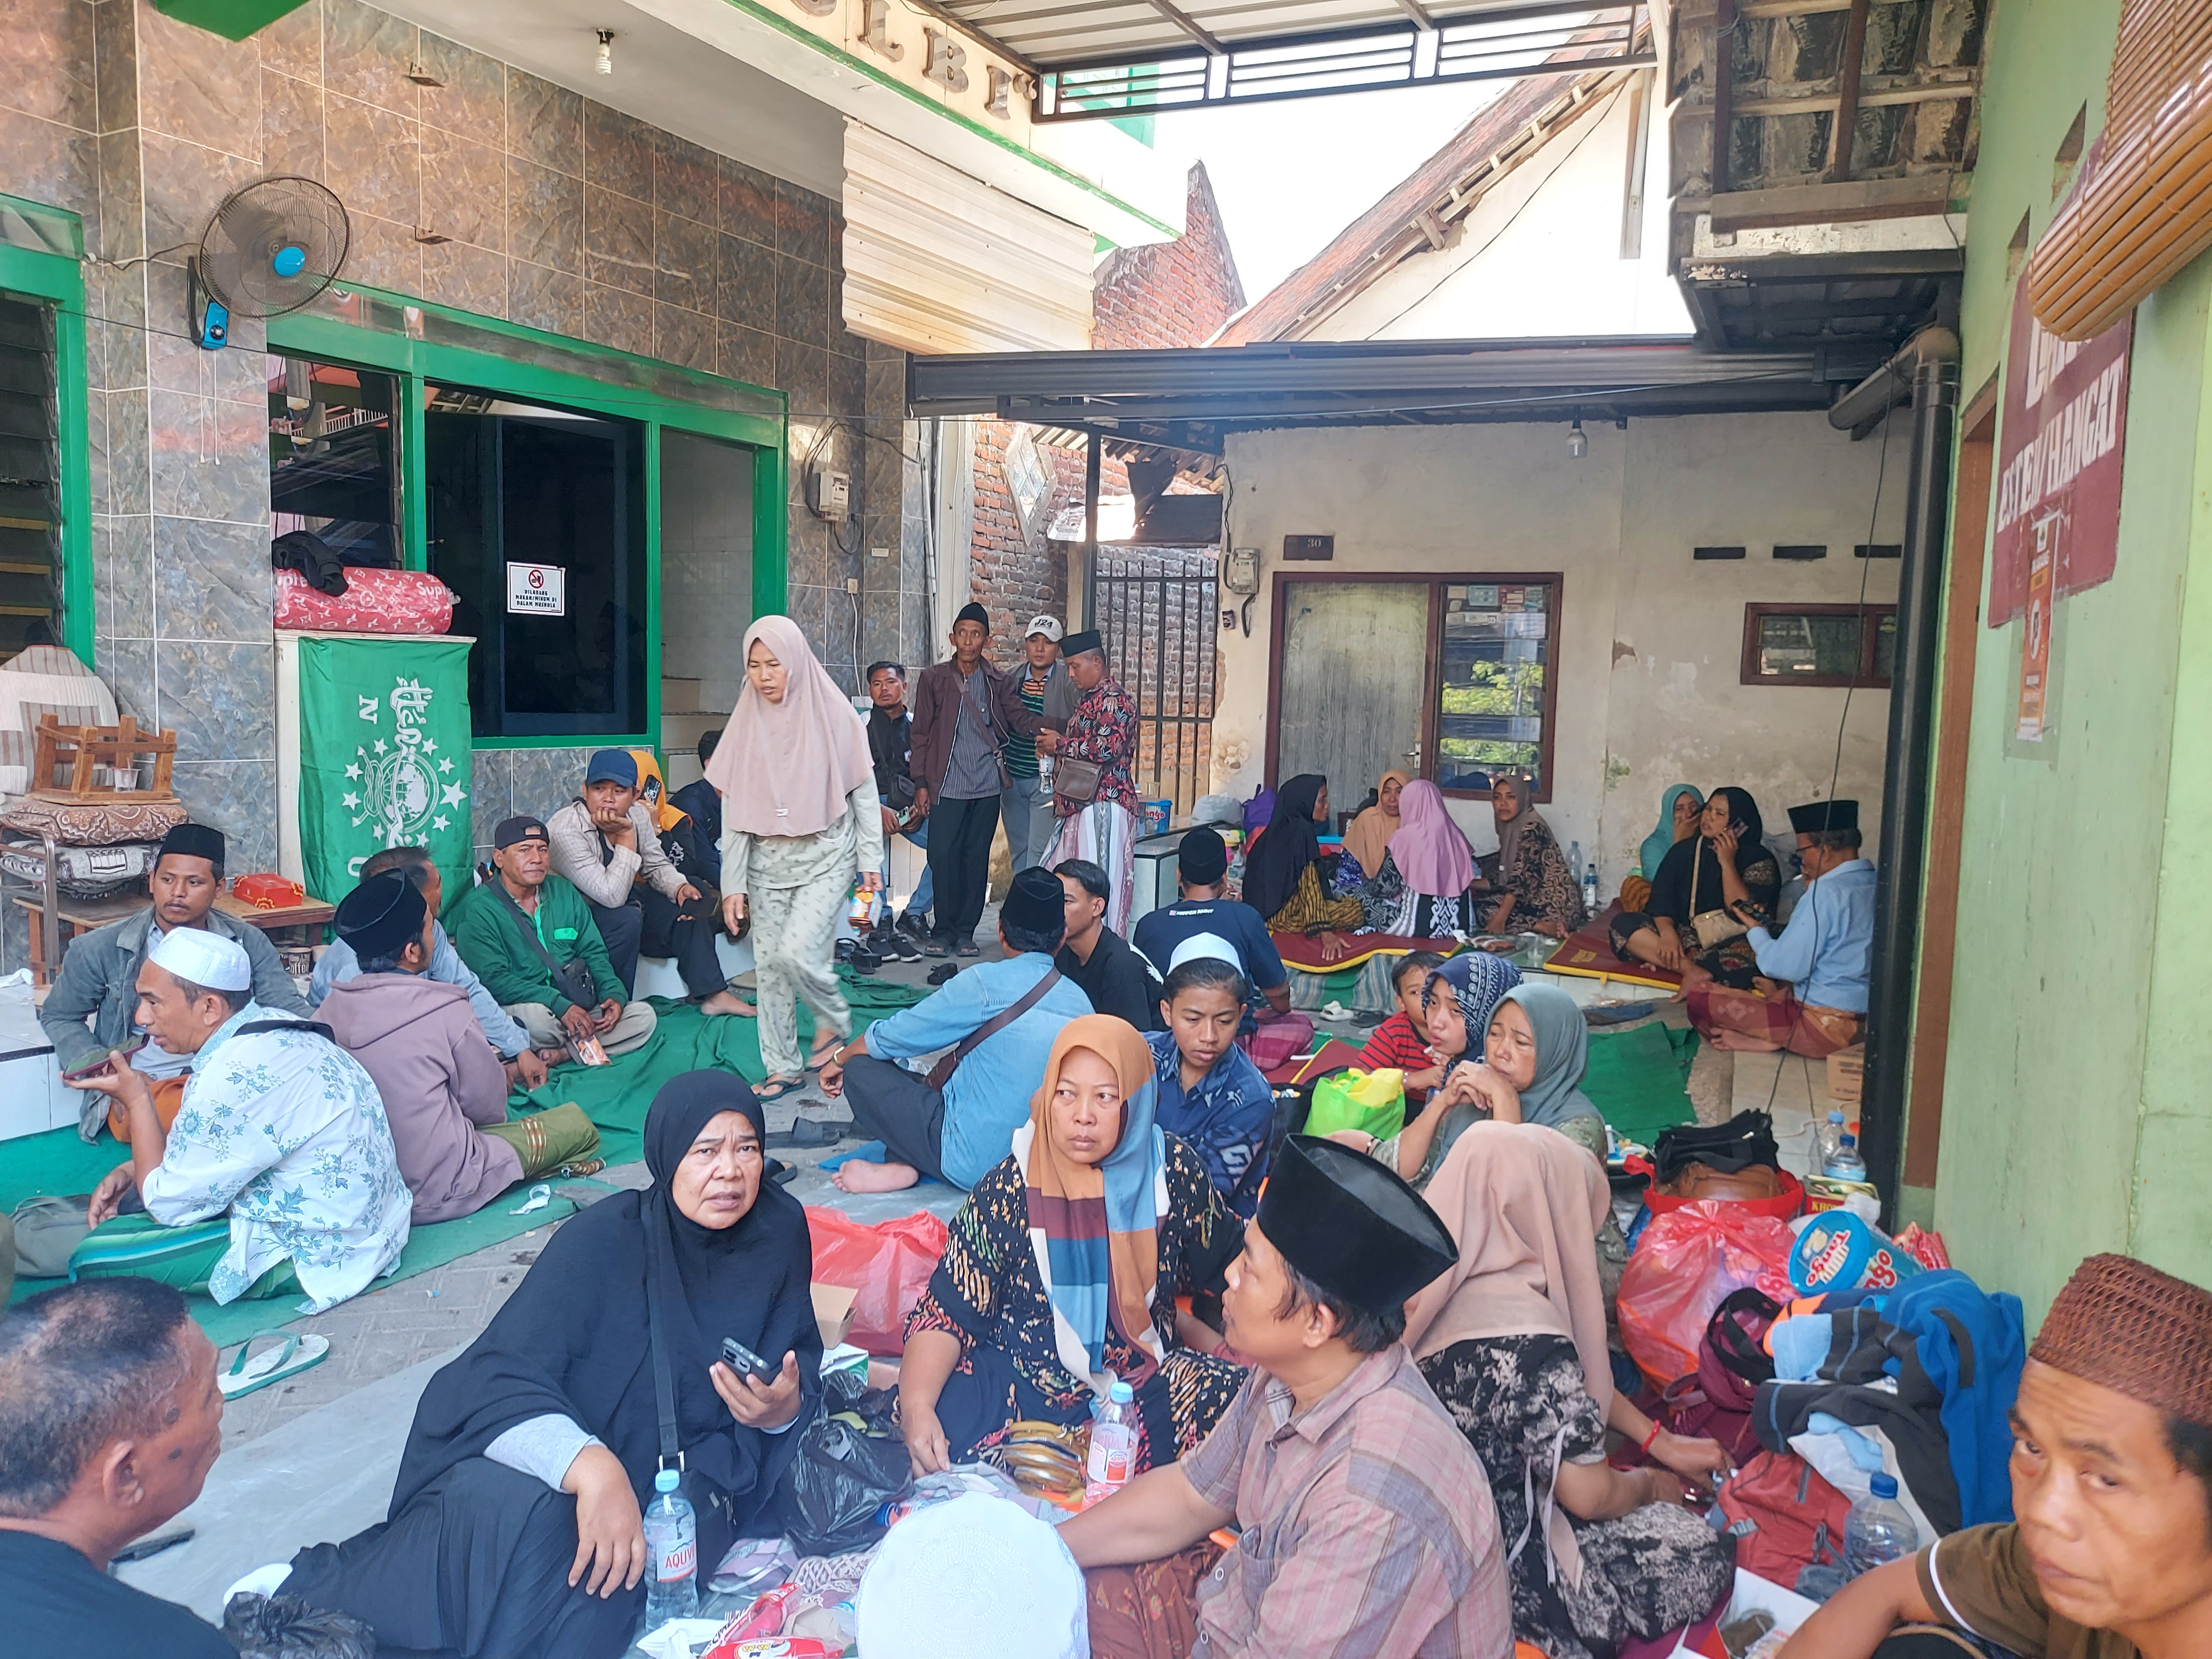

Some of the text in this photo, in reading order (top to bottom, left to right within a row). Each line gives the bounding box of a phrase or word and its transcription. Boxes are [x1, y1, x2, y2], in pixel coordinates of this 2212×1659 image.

[1307, 538, 1322, 548] 30
[358, 694, 379, 725] N
[1806, 1229, 1851, 1287] Tango
